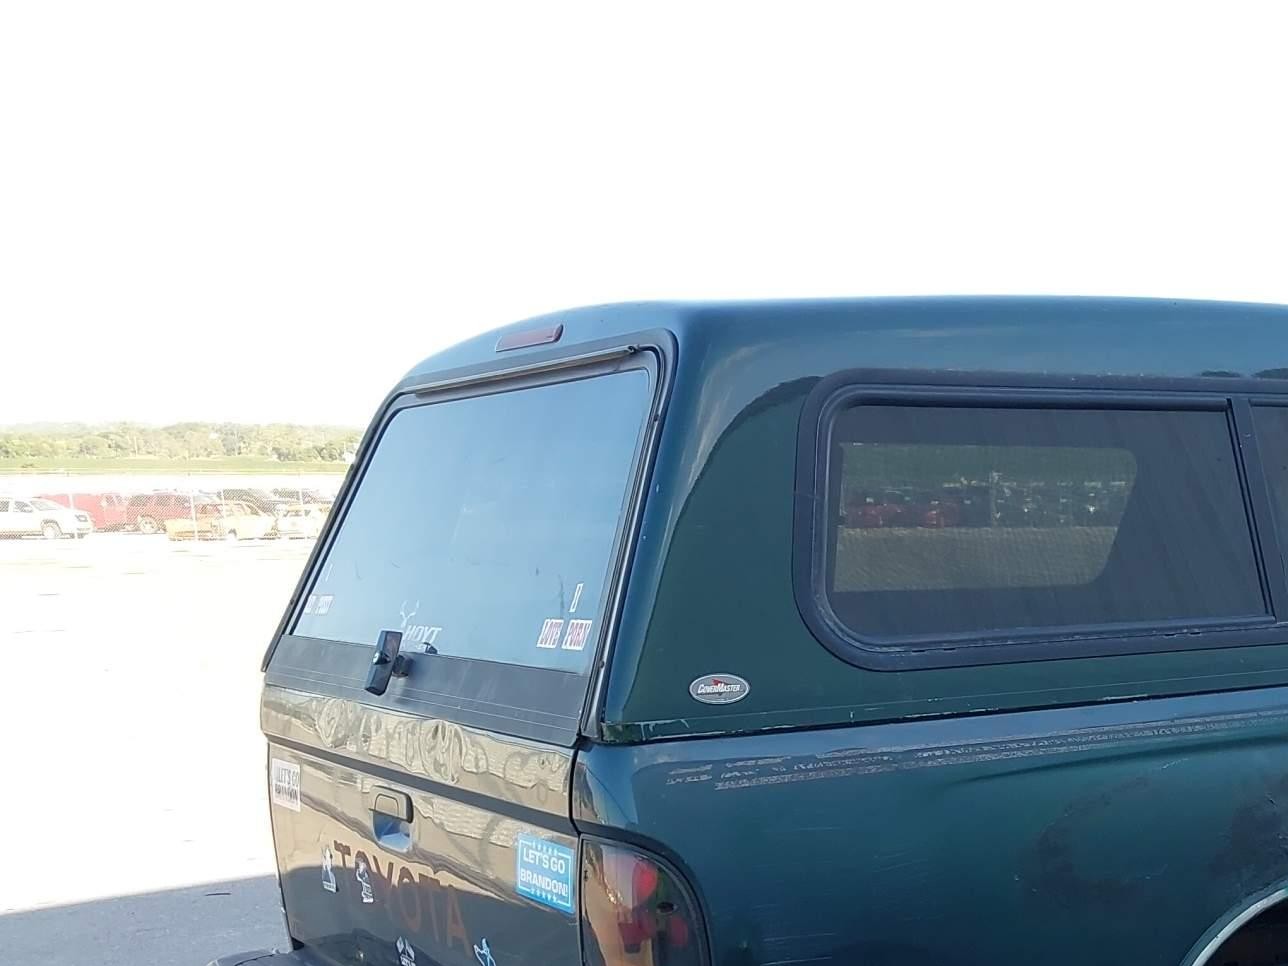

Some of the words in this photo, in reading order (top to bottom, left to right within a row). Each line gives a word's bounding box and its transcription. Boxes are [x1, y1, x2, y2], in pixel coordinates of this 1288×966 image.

[549, 856, 566, 875] GO
[520, 867, 569, 898] BRANDON!
[333, 839, 473, 958] TOYOTA
